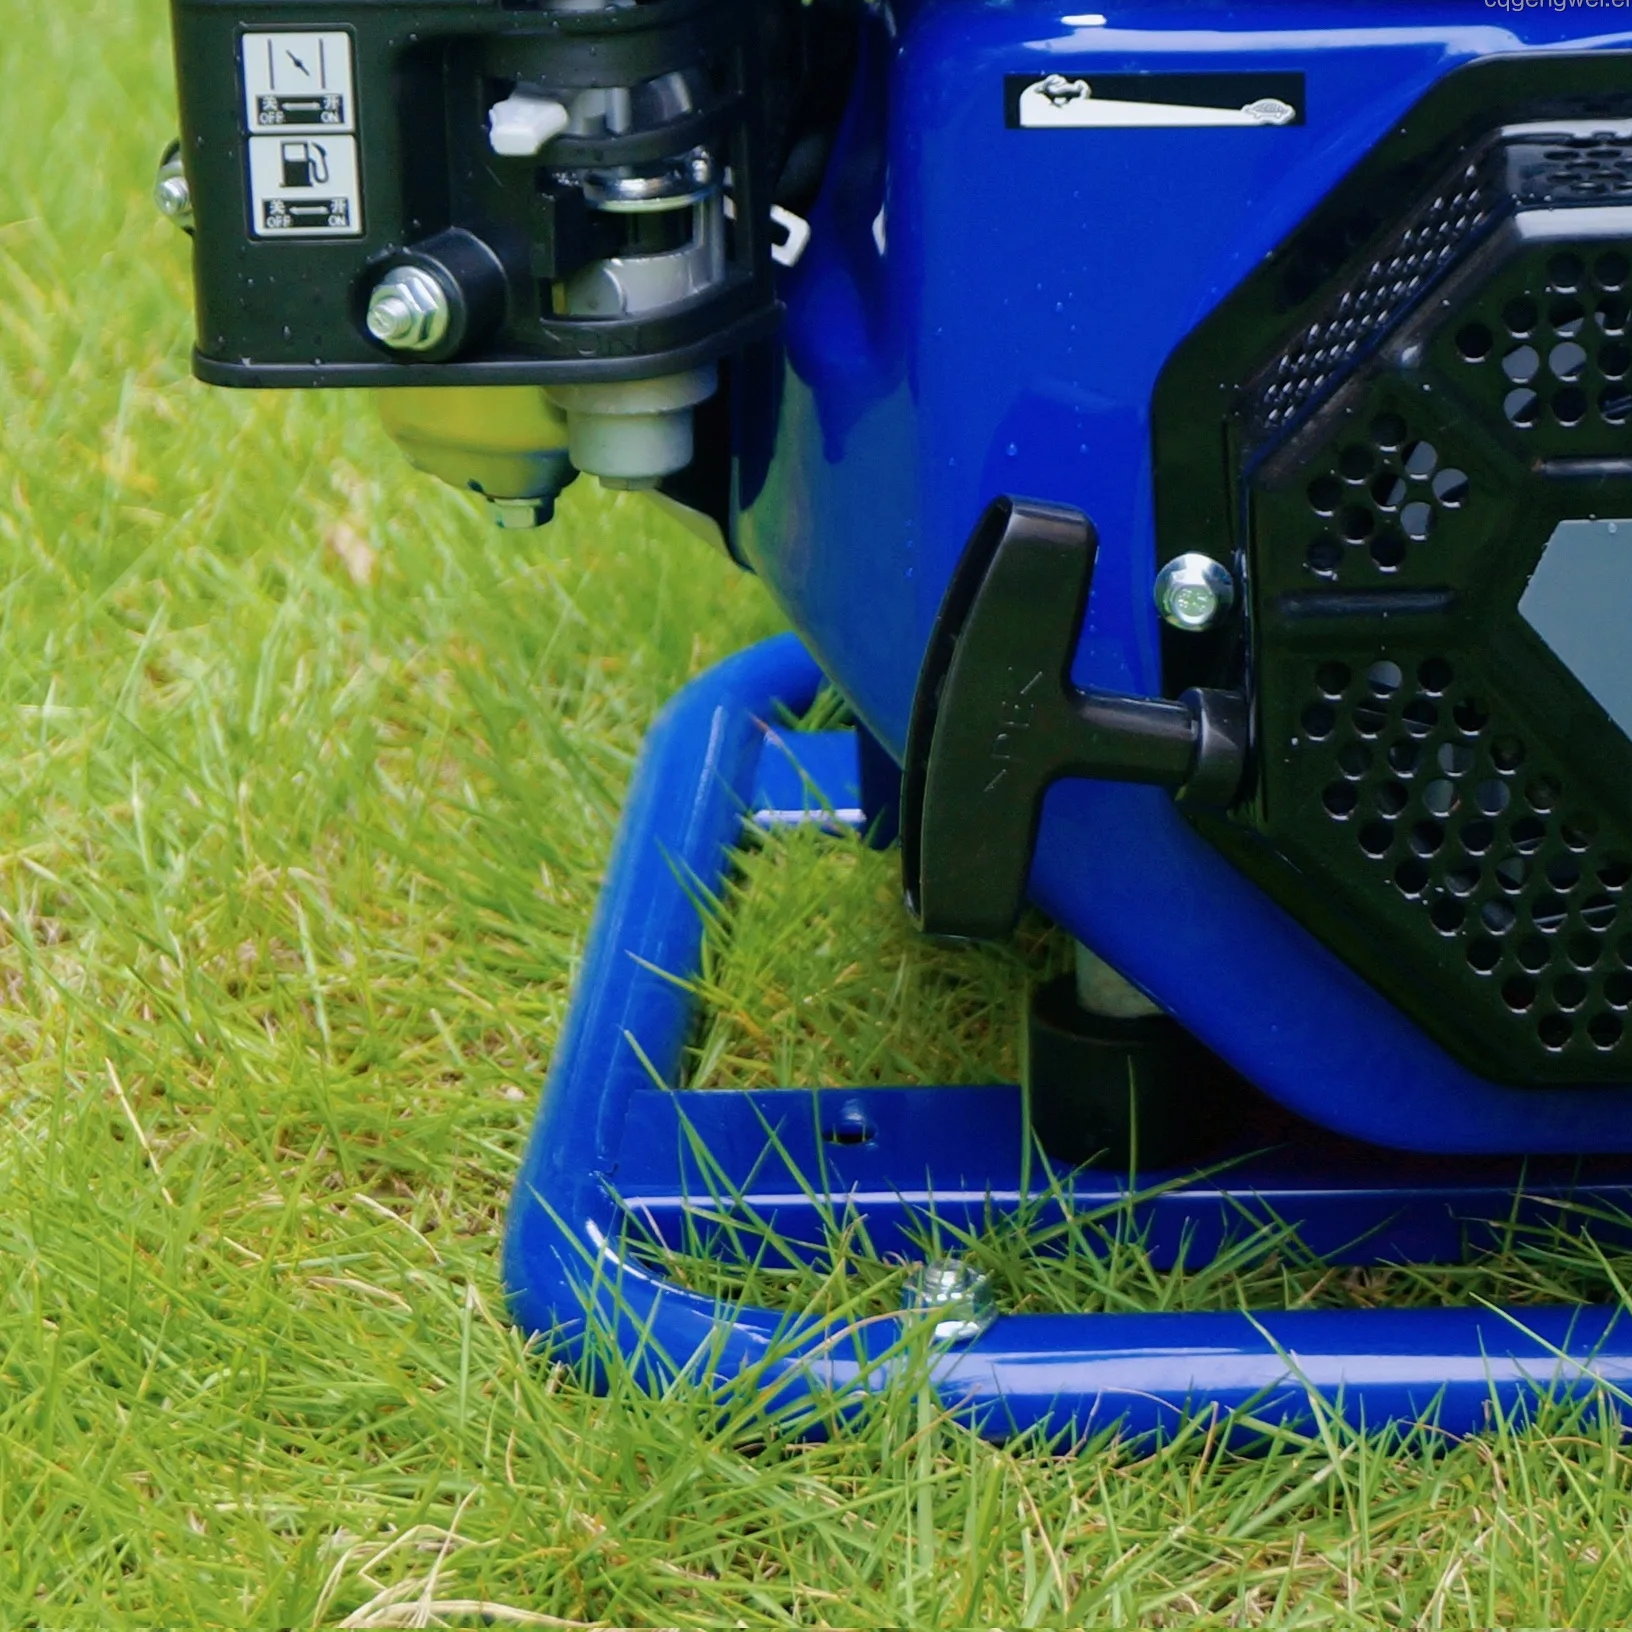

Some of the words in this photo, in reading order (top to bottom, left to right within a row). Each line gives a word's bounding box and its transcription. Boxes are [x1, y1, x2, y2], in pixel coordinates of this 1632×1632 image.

[259, 110, 285, 124] OFF
[321, 110, 340, 124] ON
[266, 215, 291, 228] OFF
[328, 214, 347, 228] ON
